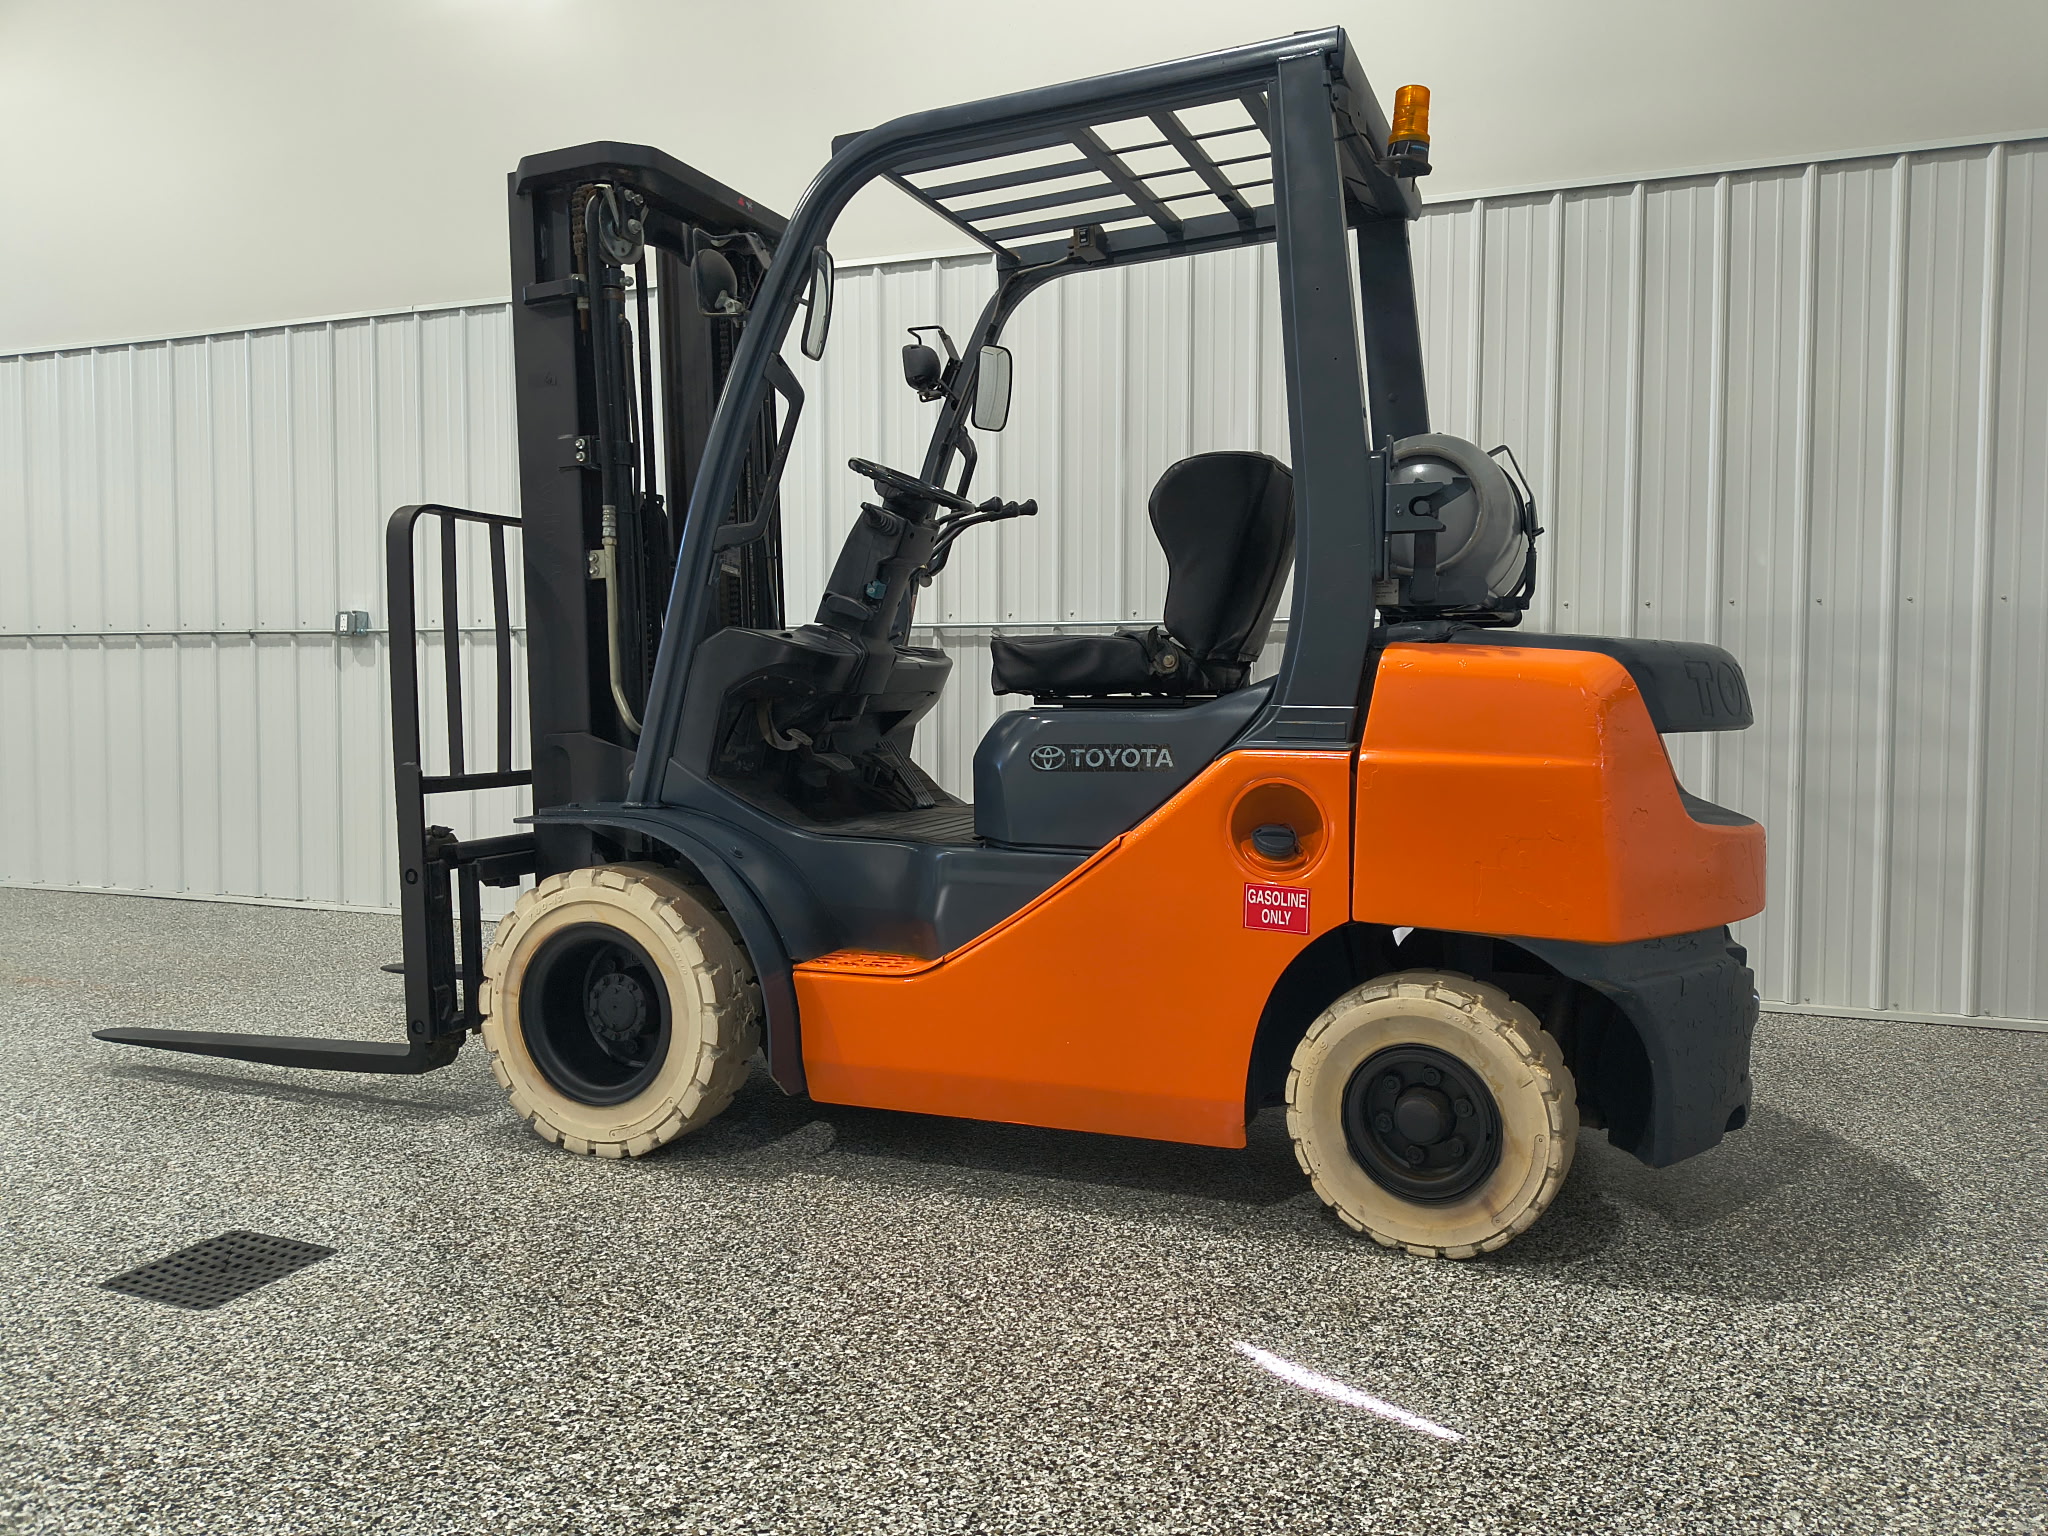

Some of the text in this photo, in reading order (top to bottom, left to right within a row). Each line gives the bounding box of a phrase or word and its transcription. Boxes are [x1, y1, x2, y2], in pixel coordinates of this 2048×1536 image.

[1071, 748, 1174, 768] TOYOTA
[1247, 889, 1307, 909] GASOLINE
[1261, 908, 1292, 926] ONLY
